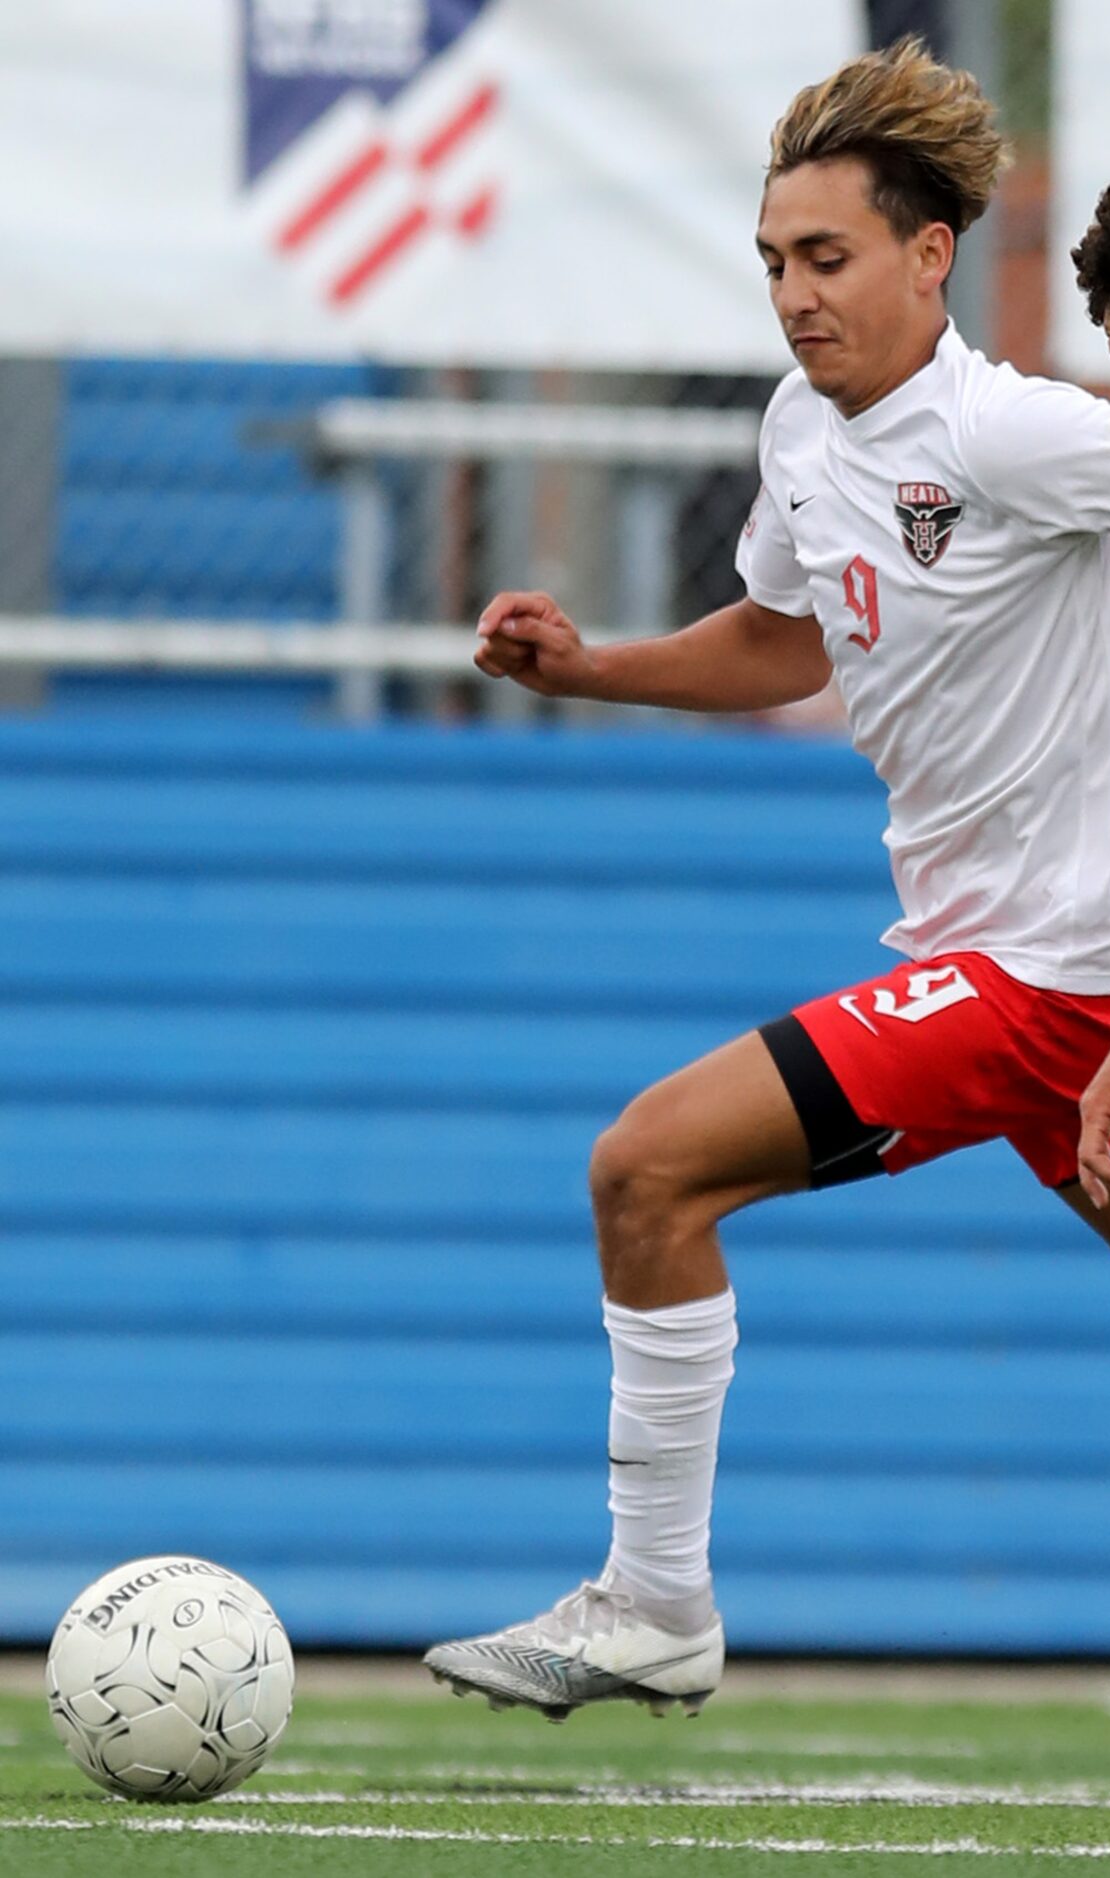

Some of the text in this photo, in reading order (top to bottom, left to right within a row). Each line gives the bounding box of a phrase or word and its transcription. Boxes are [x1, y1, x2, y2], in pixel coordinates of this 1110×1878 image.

[900, 484, 948, 503] HEATH
[842, 554, 881, 654] 9
[872, 964, 980, 1023] 9
